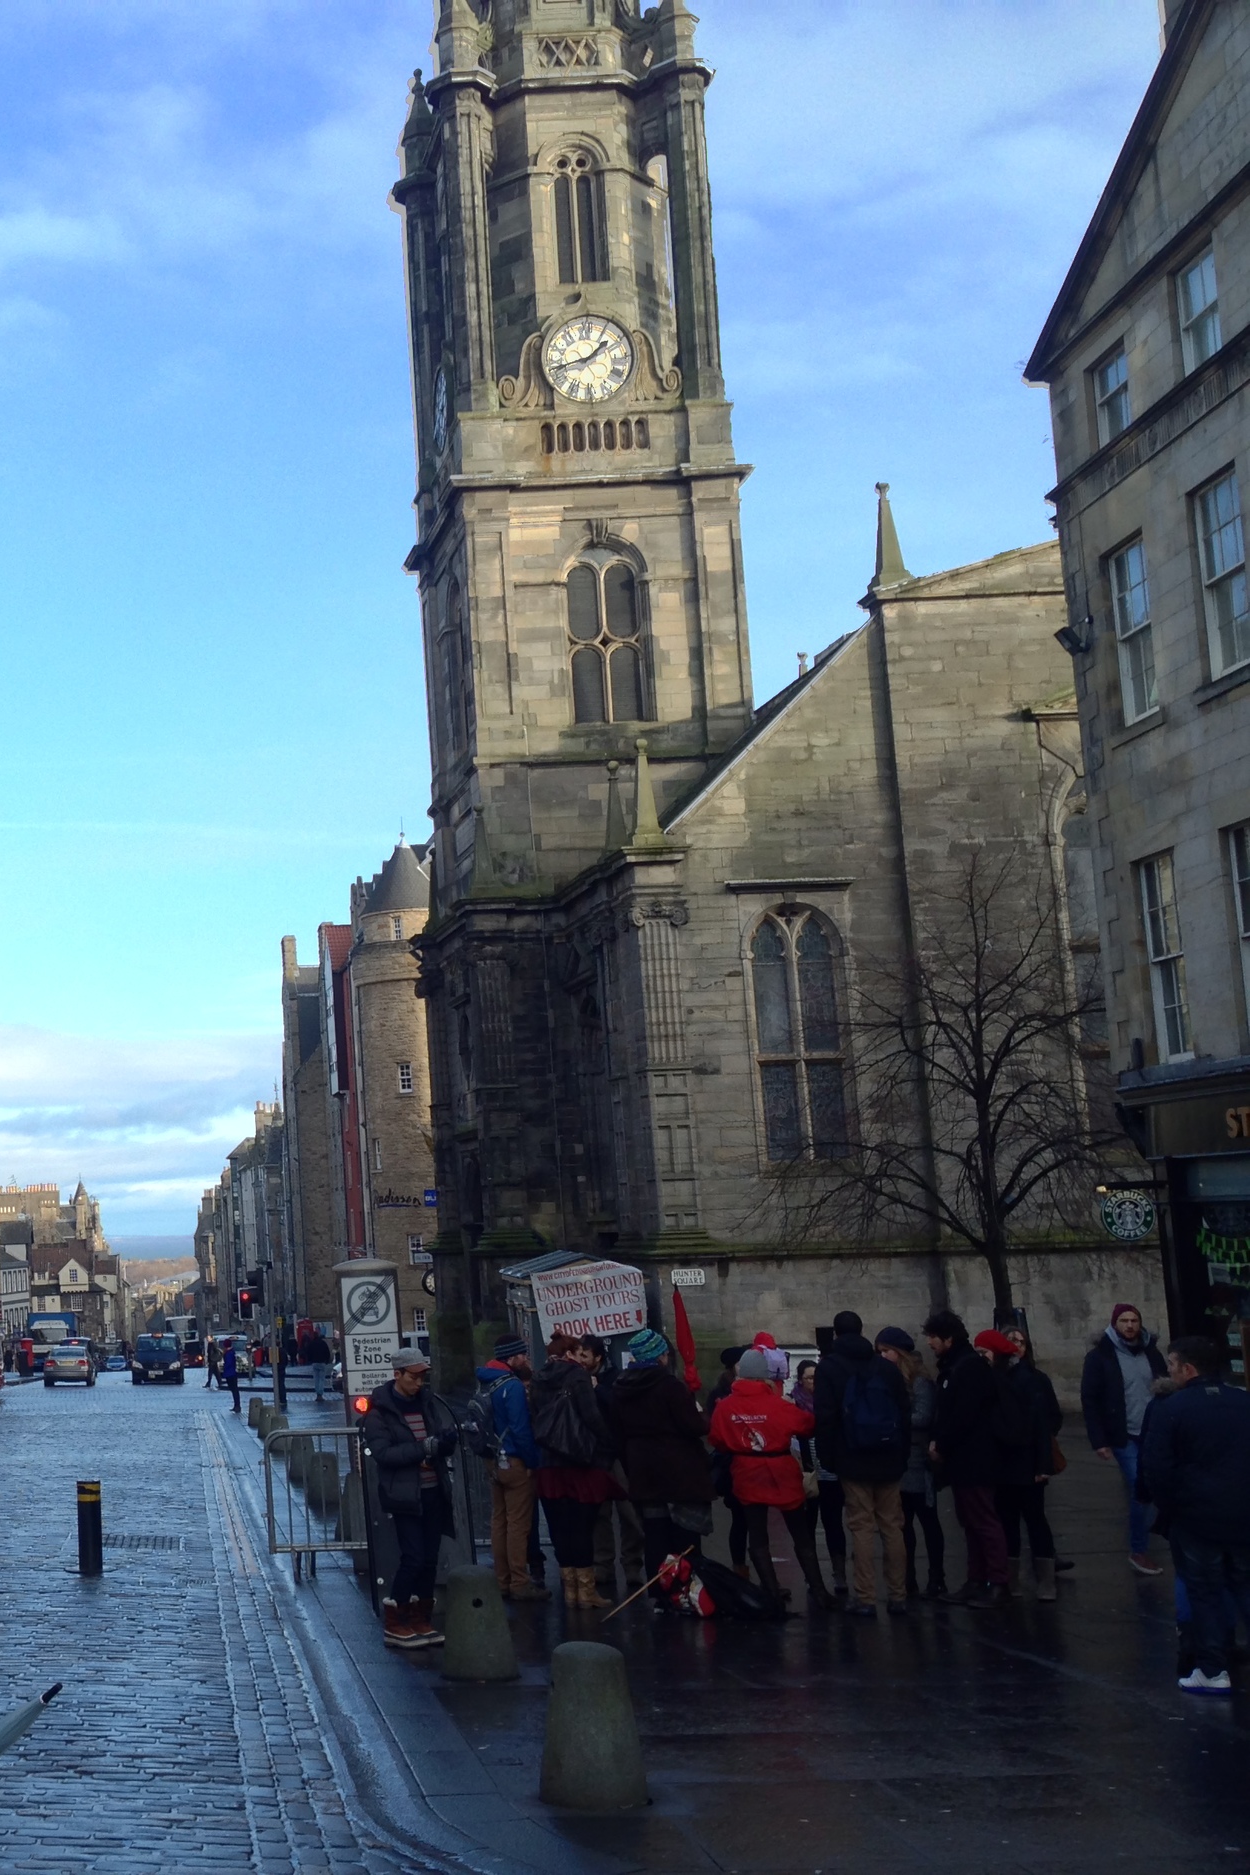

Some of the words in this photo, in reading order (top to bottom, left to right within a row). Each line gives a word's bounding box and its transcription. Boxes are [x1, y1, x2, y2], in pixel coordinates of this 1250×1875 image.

[1104, 1191, 1151, 1214] STARBUCKS
[1111, 1225, 1148, 1238] COFFEE
[536, 1272, 642, 1302] UNDERGROUND
[673, 1277, 703, 1285] SQUARE
[545, 1297, 590, 1317] GHOST
[593, 1290, 640, 1309] TOURS
[553, 1318, 592, 1337] BOOK
[594, 1311, 633, 1332] HERE
[352, 1337, 392, 1345] Pedestrian
[355, 1353, 392, 1364] ENDS
